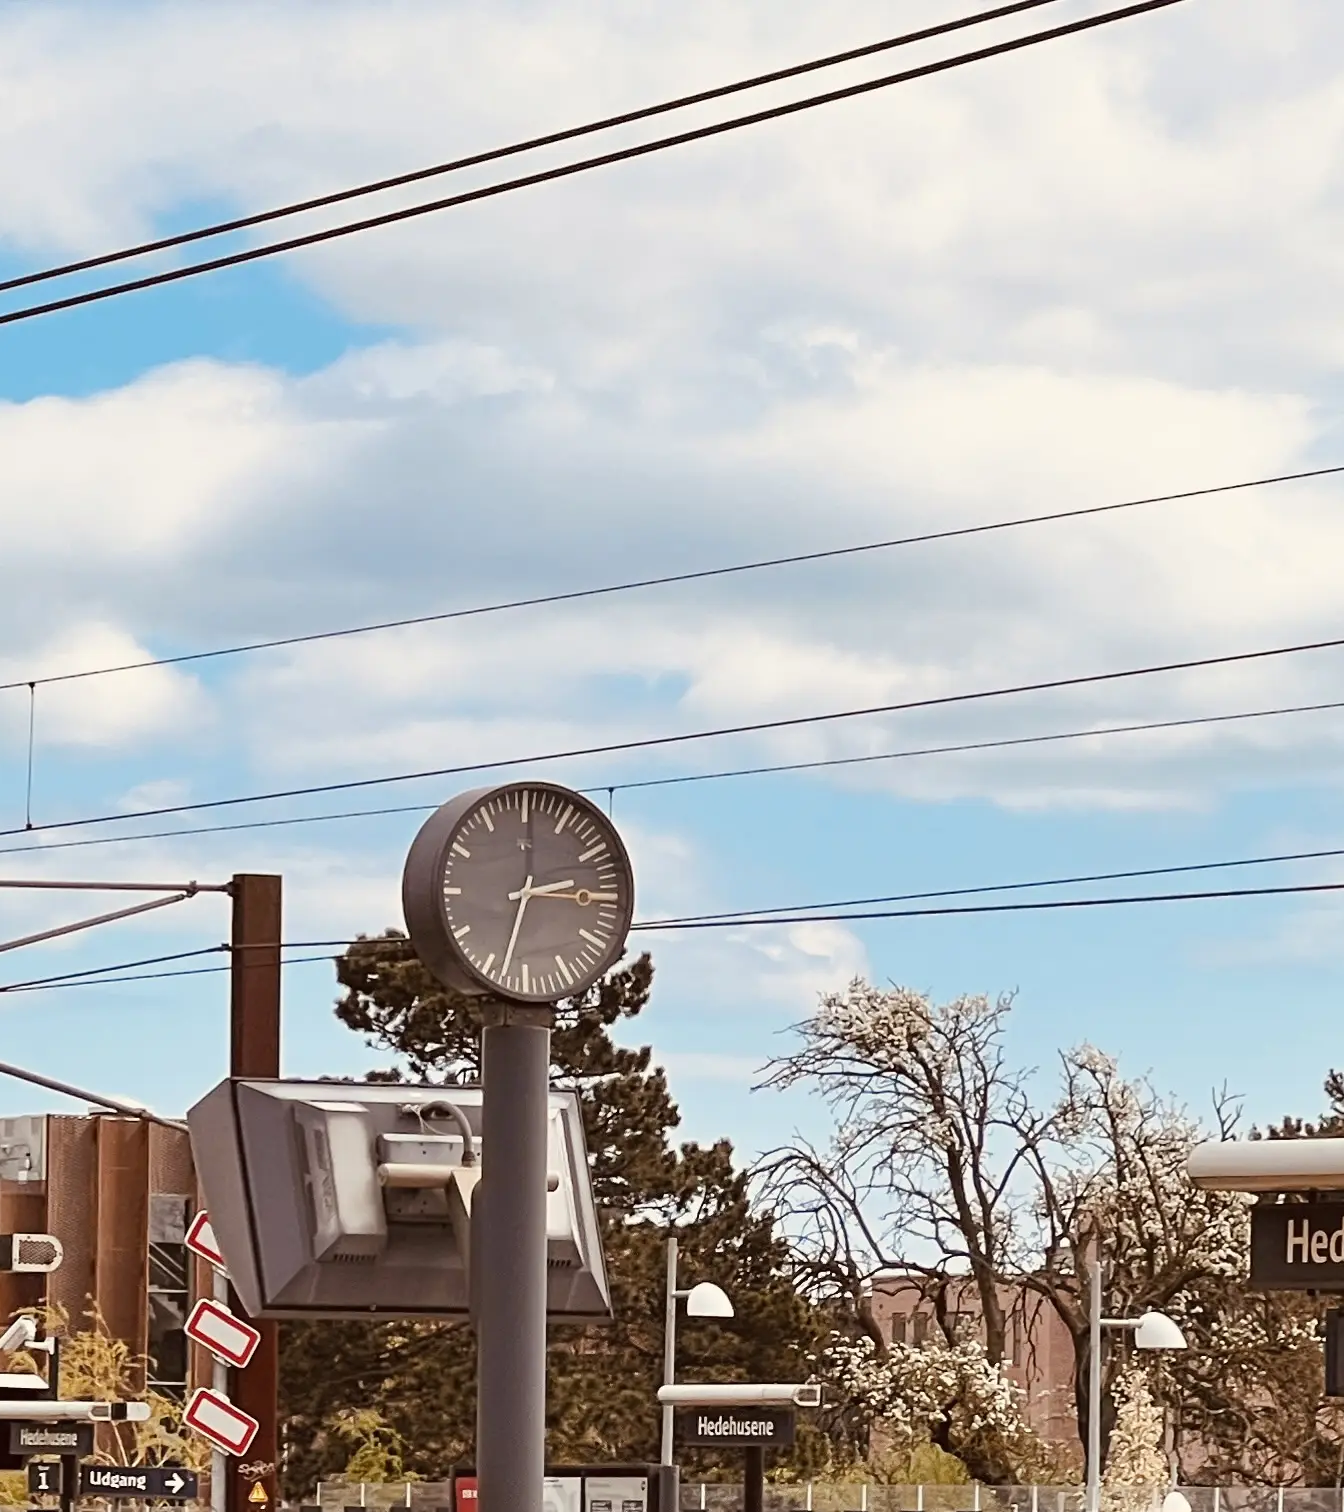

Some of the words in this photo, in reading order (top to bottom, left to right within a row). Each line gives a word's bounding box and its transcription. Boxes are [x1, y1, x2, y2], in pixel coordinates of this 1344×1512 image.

[697, 1415, 775, 1436] Hedehusene
[37, 1471, 50, 1490] 1
[89, 1470, 147, 1491] Udgang
